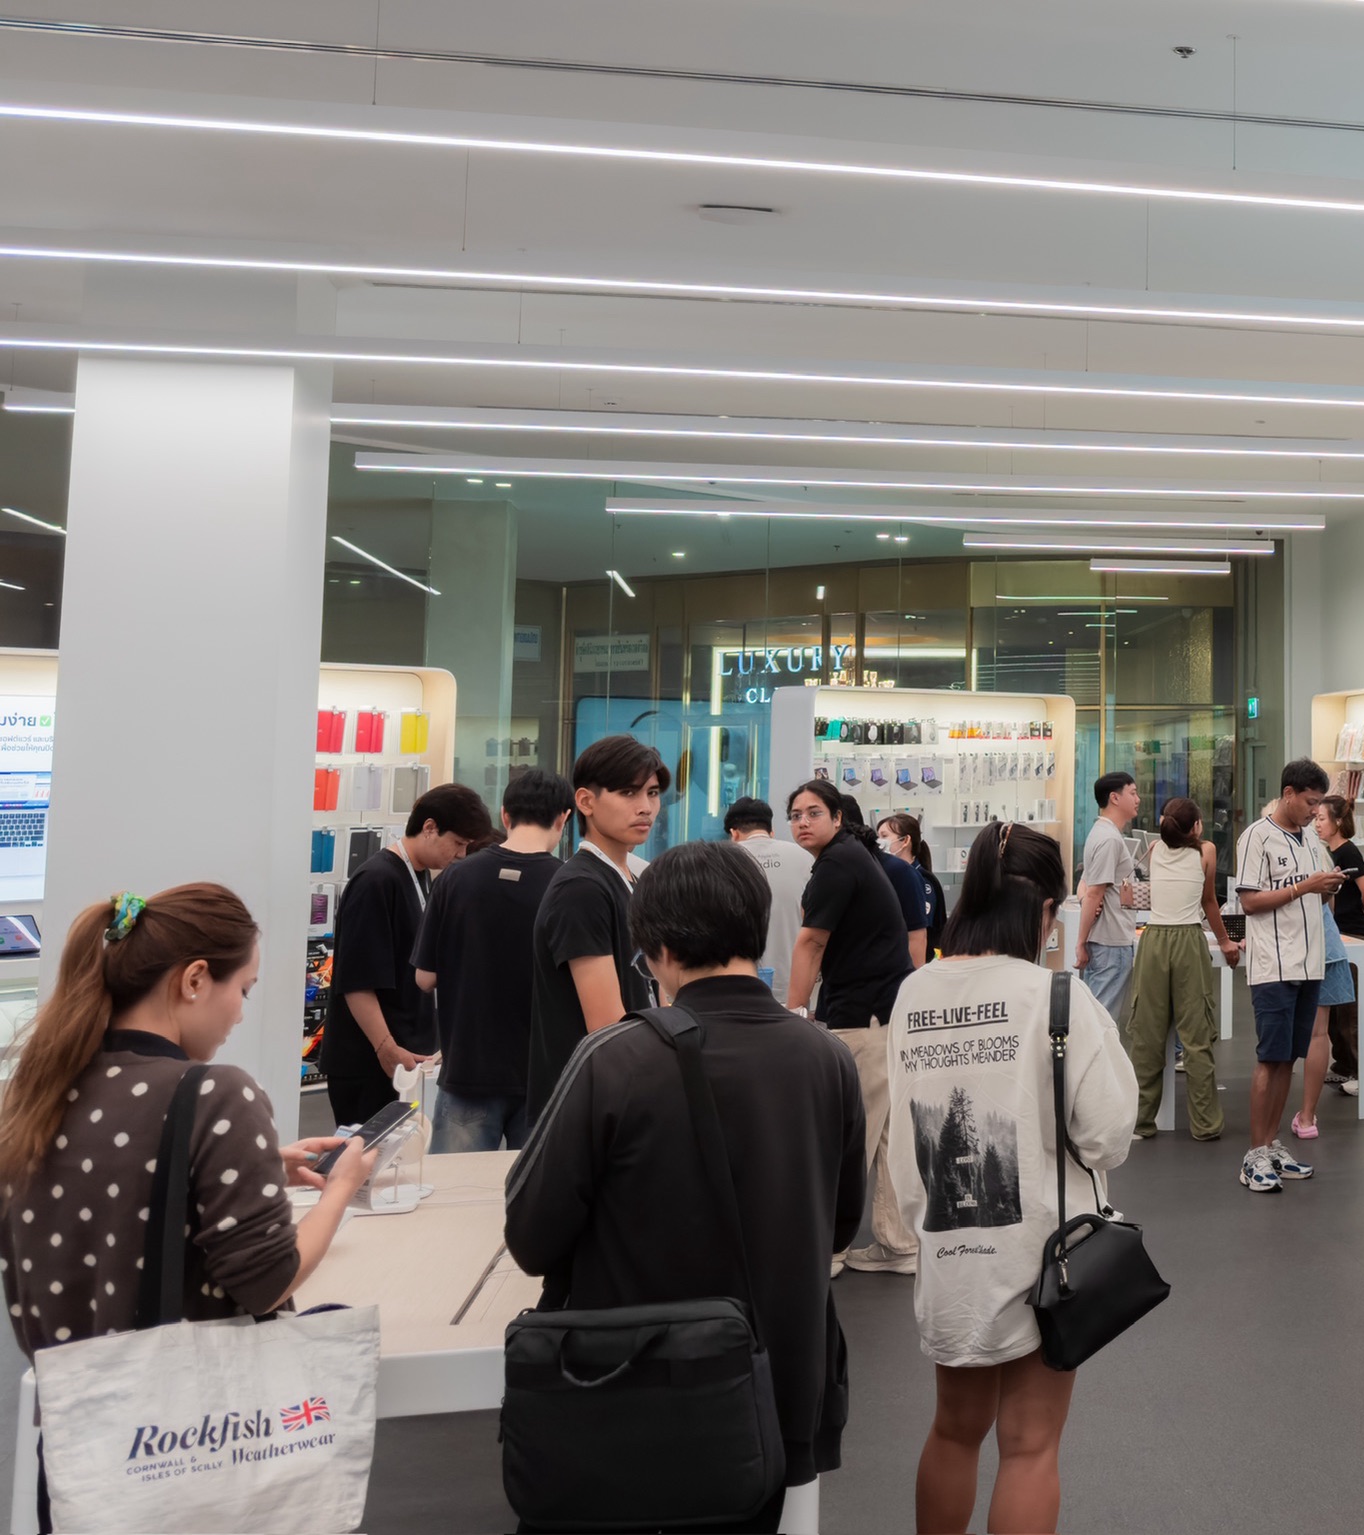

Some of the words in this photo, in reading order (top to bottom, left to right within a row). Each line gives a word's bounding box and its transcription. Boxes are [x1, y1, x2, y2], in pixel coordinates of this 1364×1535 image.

[719, 645, 850, 676] LUXURY
[745, 687, 779, 704] CL
[907, 1001, 1009, 1030] FREE-LIVE-FEEL
[900, 1049, 909, 1062] IN
[910, 1041, 960, 1060] MEADOWS
[962, 1039, 975, 1053] OF
[977, 1034, 1020, 1051] BLOOMS
[904, 1060, 918, 1073] MY
[920, 1053, 970, 1071] THOUGHTS
[971, 1048, 1017, 1065] MEANDER
[937, 1246, 957, 1259] Cool
[127, 1409, 274, 1461] Rockfish
[231, 1432, 337, 1466] Weatherwear
[126, 1458, 184, 1476] CORNWALL
[141, 1470, 171, 1483] ISLES
[174, 1467, 187, 1477] OF
[190, 1460, 223, 1474] SCILLY
